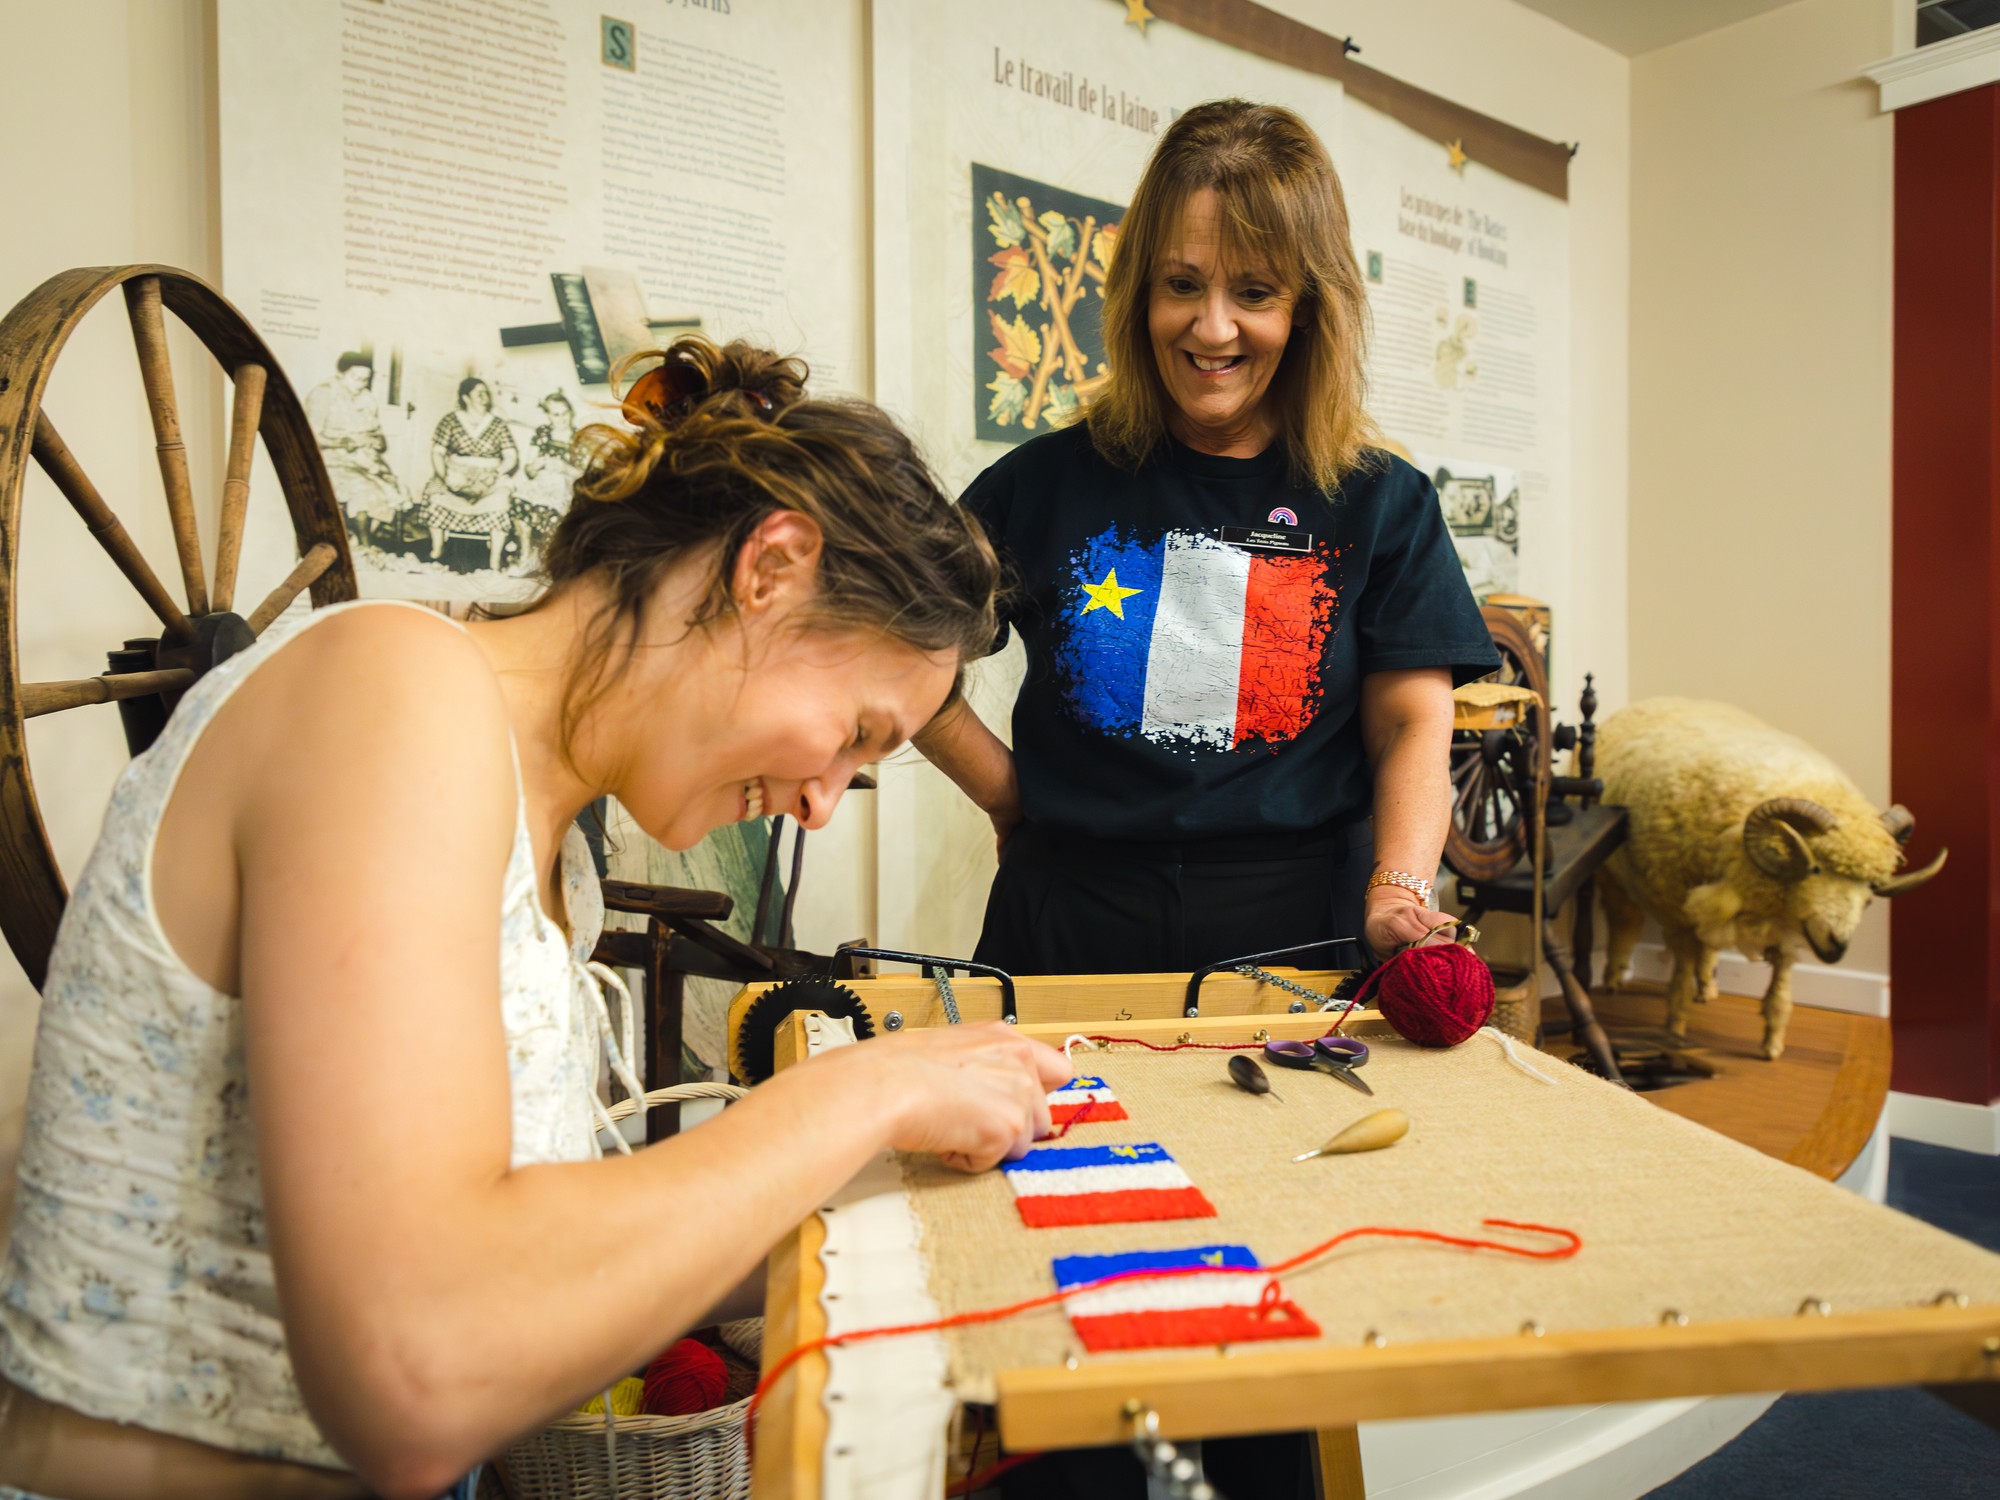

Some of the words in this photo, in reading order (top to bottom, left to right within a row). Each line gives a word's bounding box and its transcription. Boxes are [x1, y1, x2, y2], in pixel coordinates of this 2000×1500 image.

[994, 47, 1014, 87] Le
[1020, 58, 1073, 108] travail
[1079, 79, 1097, 114] de
[1102, 84, 1115, 121] la
[1121, 92, 1158, 134] laine
